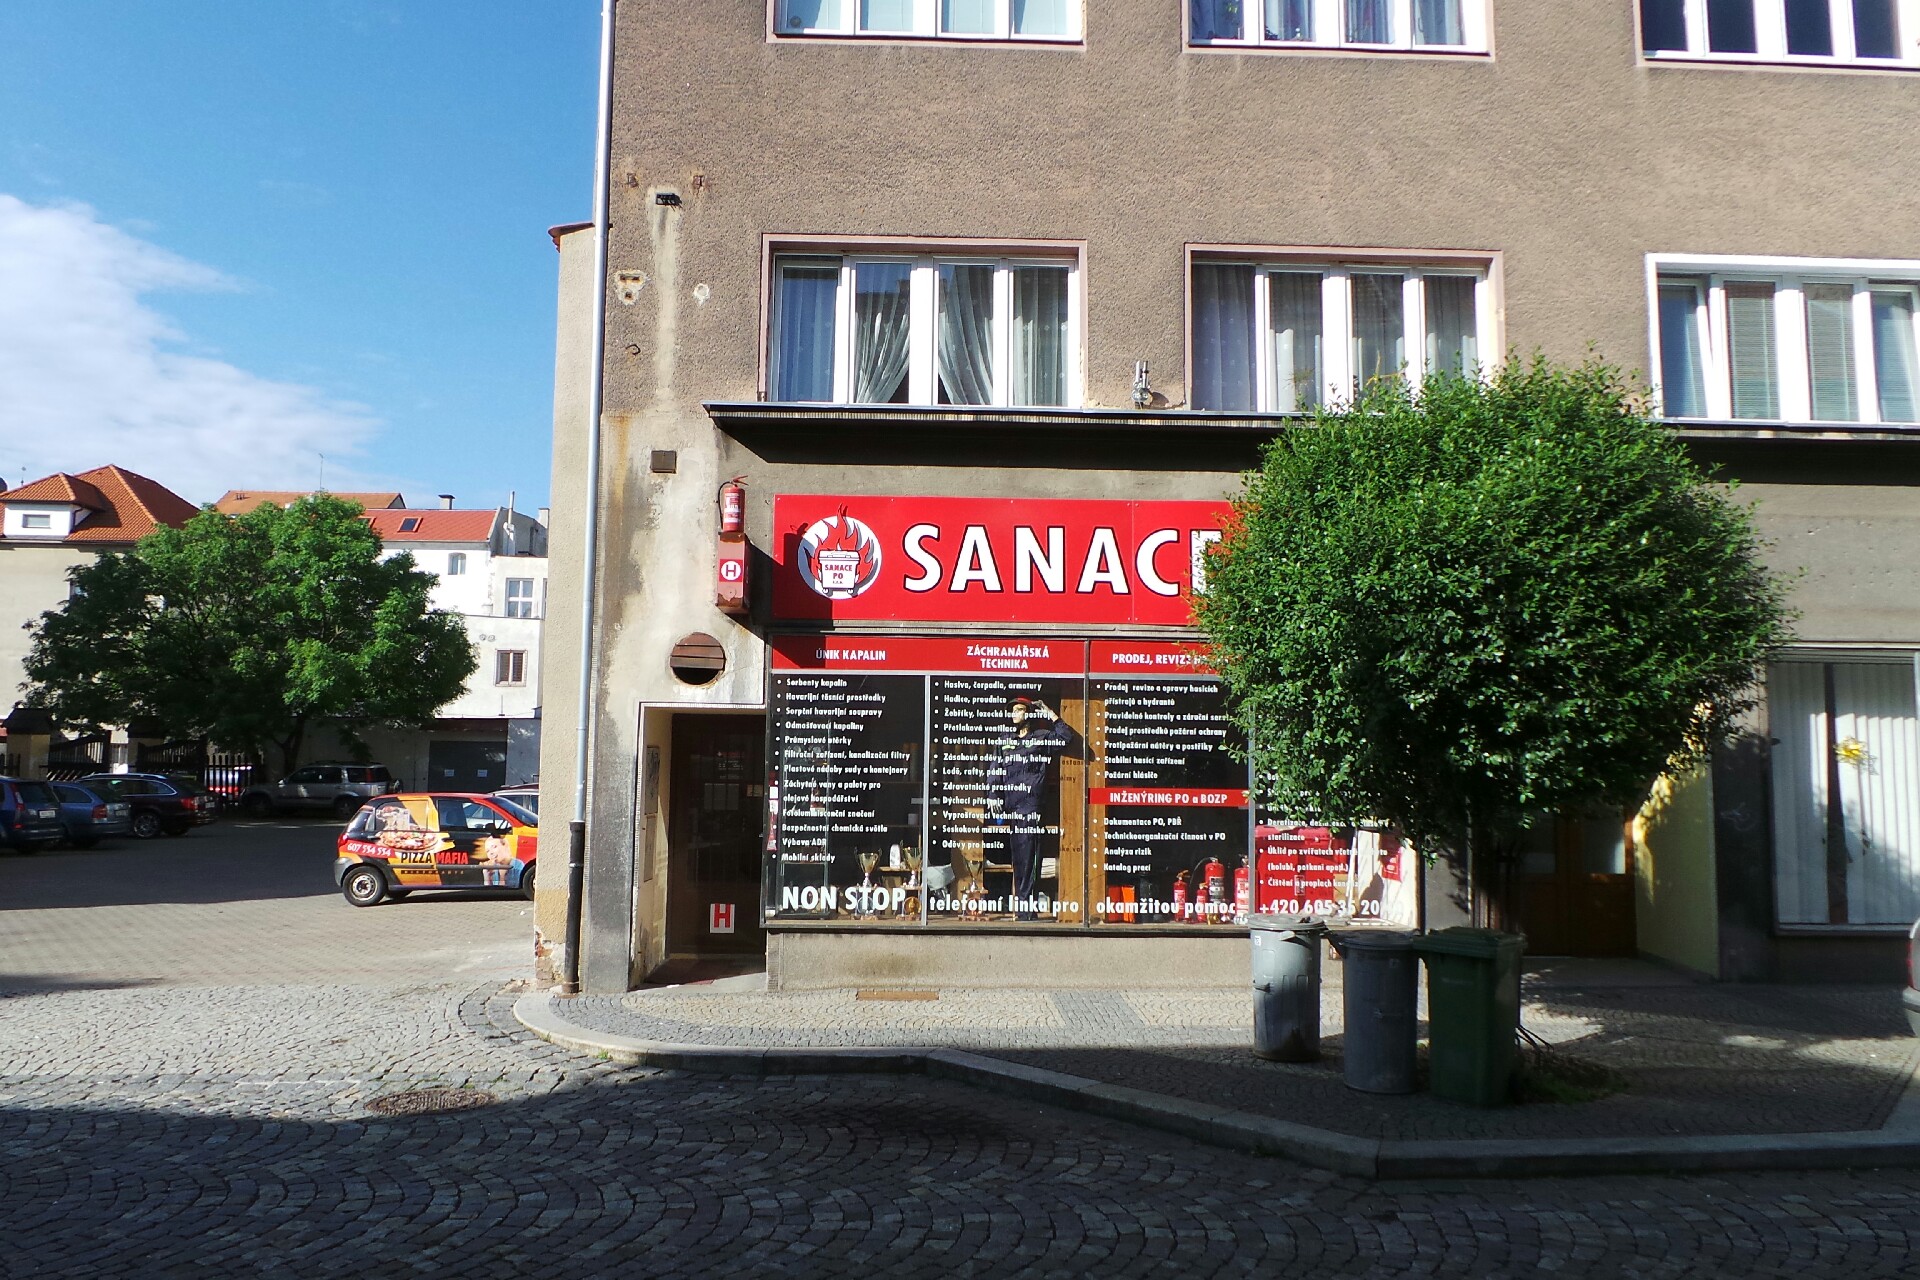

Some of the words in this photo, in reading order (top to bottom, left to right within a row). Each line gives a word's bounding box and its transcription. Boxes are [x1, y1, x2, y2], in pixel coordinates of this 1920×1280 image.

[725, 564, 737, 577] H
[824, 564, 853, 572] SANACE
[832, 572, 844, 580] PO
[816, 648, 840, 659] ÚNIK
[842, 650, 886, 660] KAPALIN
[967, 644, 1049, 658] ZÁCHRANÁŘSKÁ
[980, 659, 1028, 669] TECHNIKA
[1112, 654, 1153, 665] PRODEJ,
[1110, 791, 1172, 803] INŽENÝRING
[1175, 794, 1189, 803] PO
[1200, 794, 1227, 803] BOZP
[401, 852, 432, 863] PIZZA
[435, 851, 469, 864] MAFIA
[783, 886, 837, 910] NON
[845, 887, 906, 911] STOP
[930, 894, 1004, 911] telefonní
[1008, 895, 1049, 912] linka
[1053, 901, 1079, 917] pro
[1096, 897, 1179, 914] okamžitou
[1185, 902, 1235, 918] pomoc
[1260, 900, 1299, 914] +420
[713, 903, 731, 928] H
